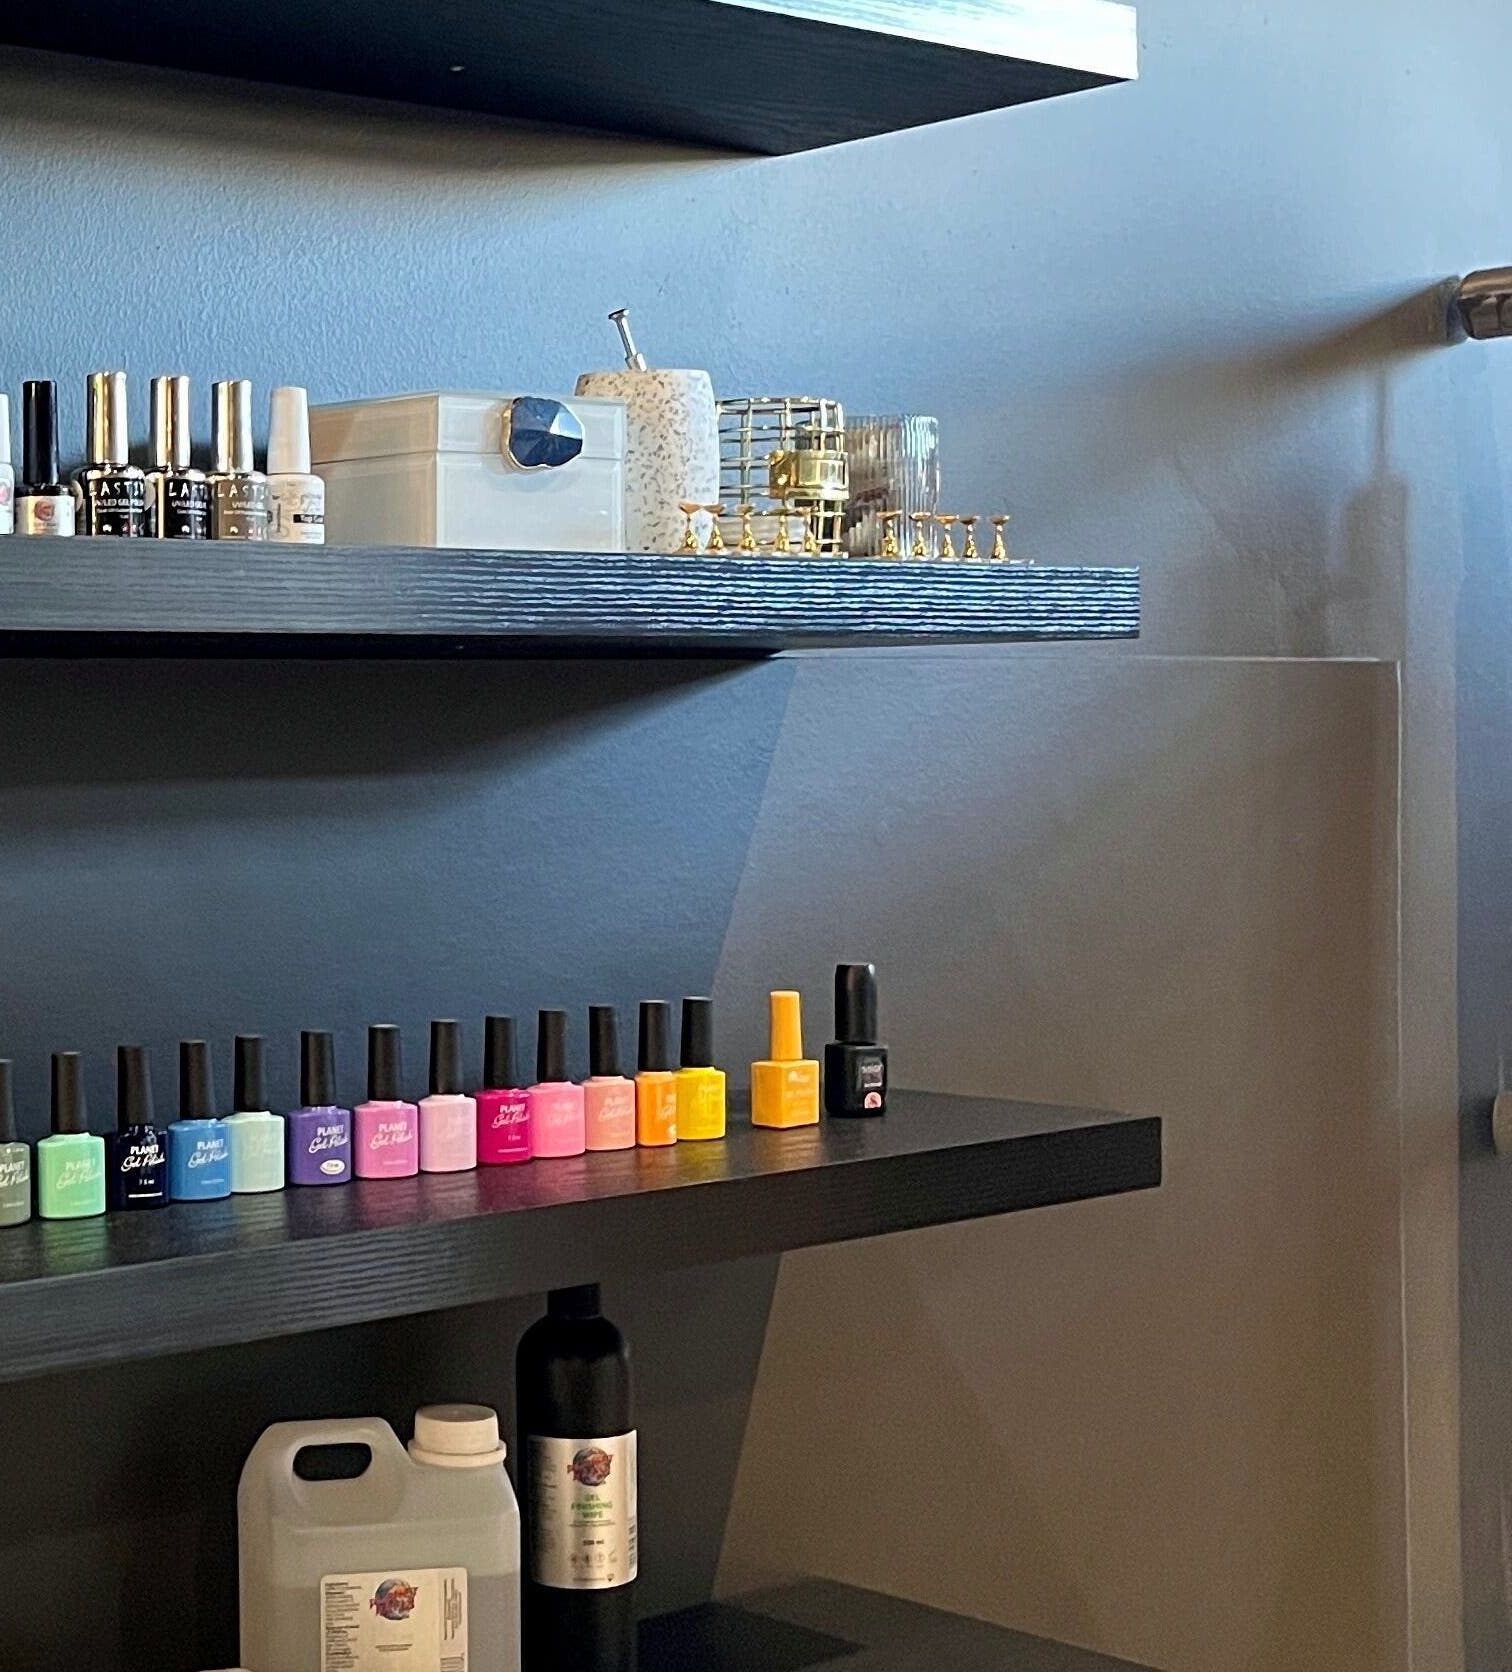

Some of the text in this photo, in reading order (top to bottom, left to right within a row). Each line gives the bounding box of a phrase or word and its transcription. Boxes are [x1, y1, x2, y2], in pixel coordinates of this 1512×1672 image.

[317, 1124, 345, 1137] PLANET
[130, 1144, 160, 1155] PLANET
[197, 1138, 225, 1150] PLANET
[0, 1160, 25, 1173] PLANET
